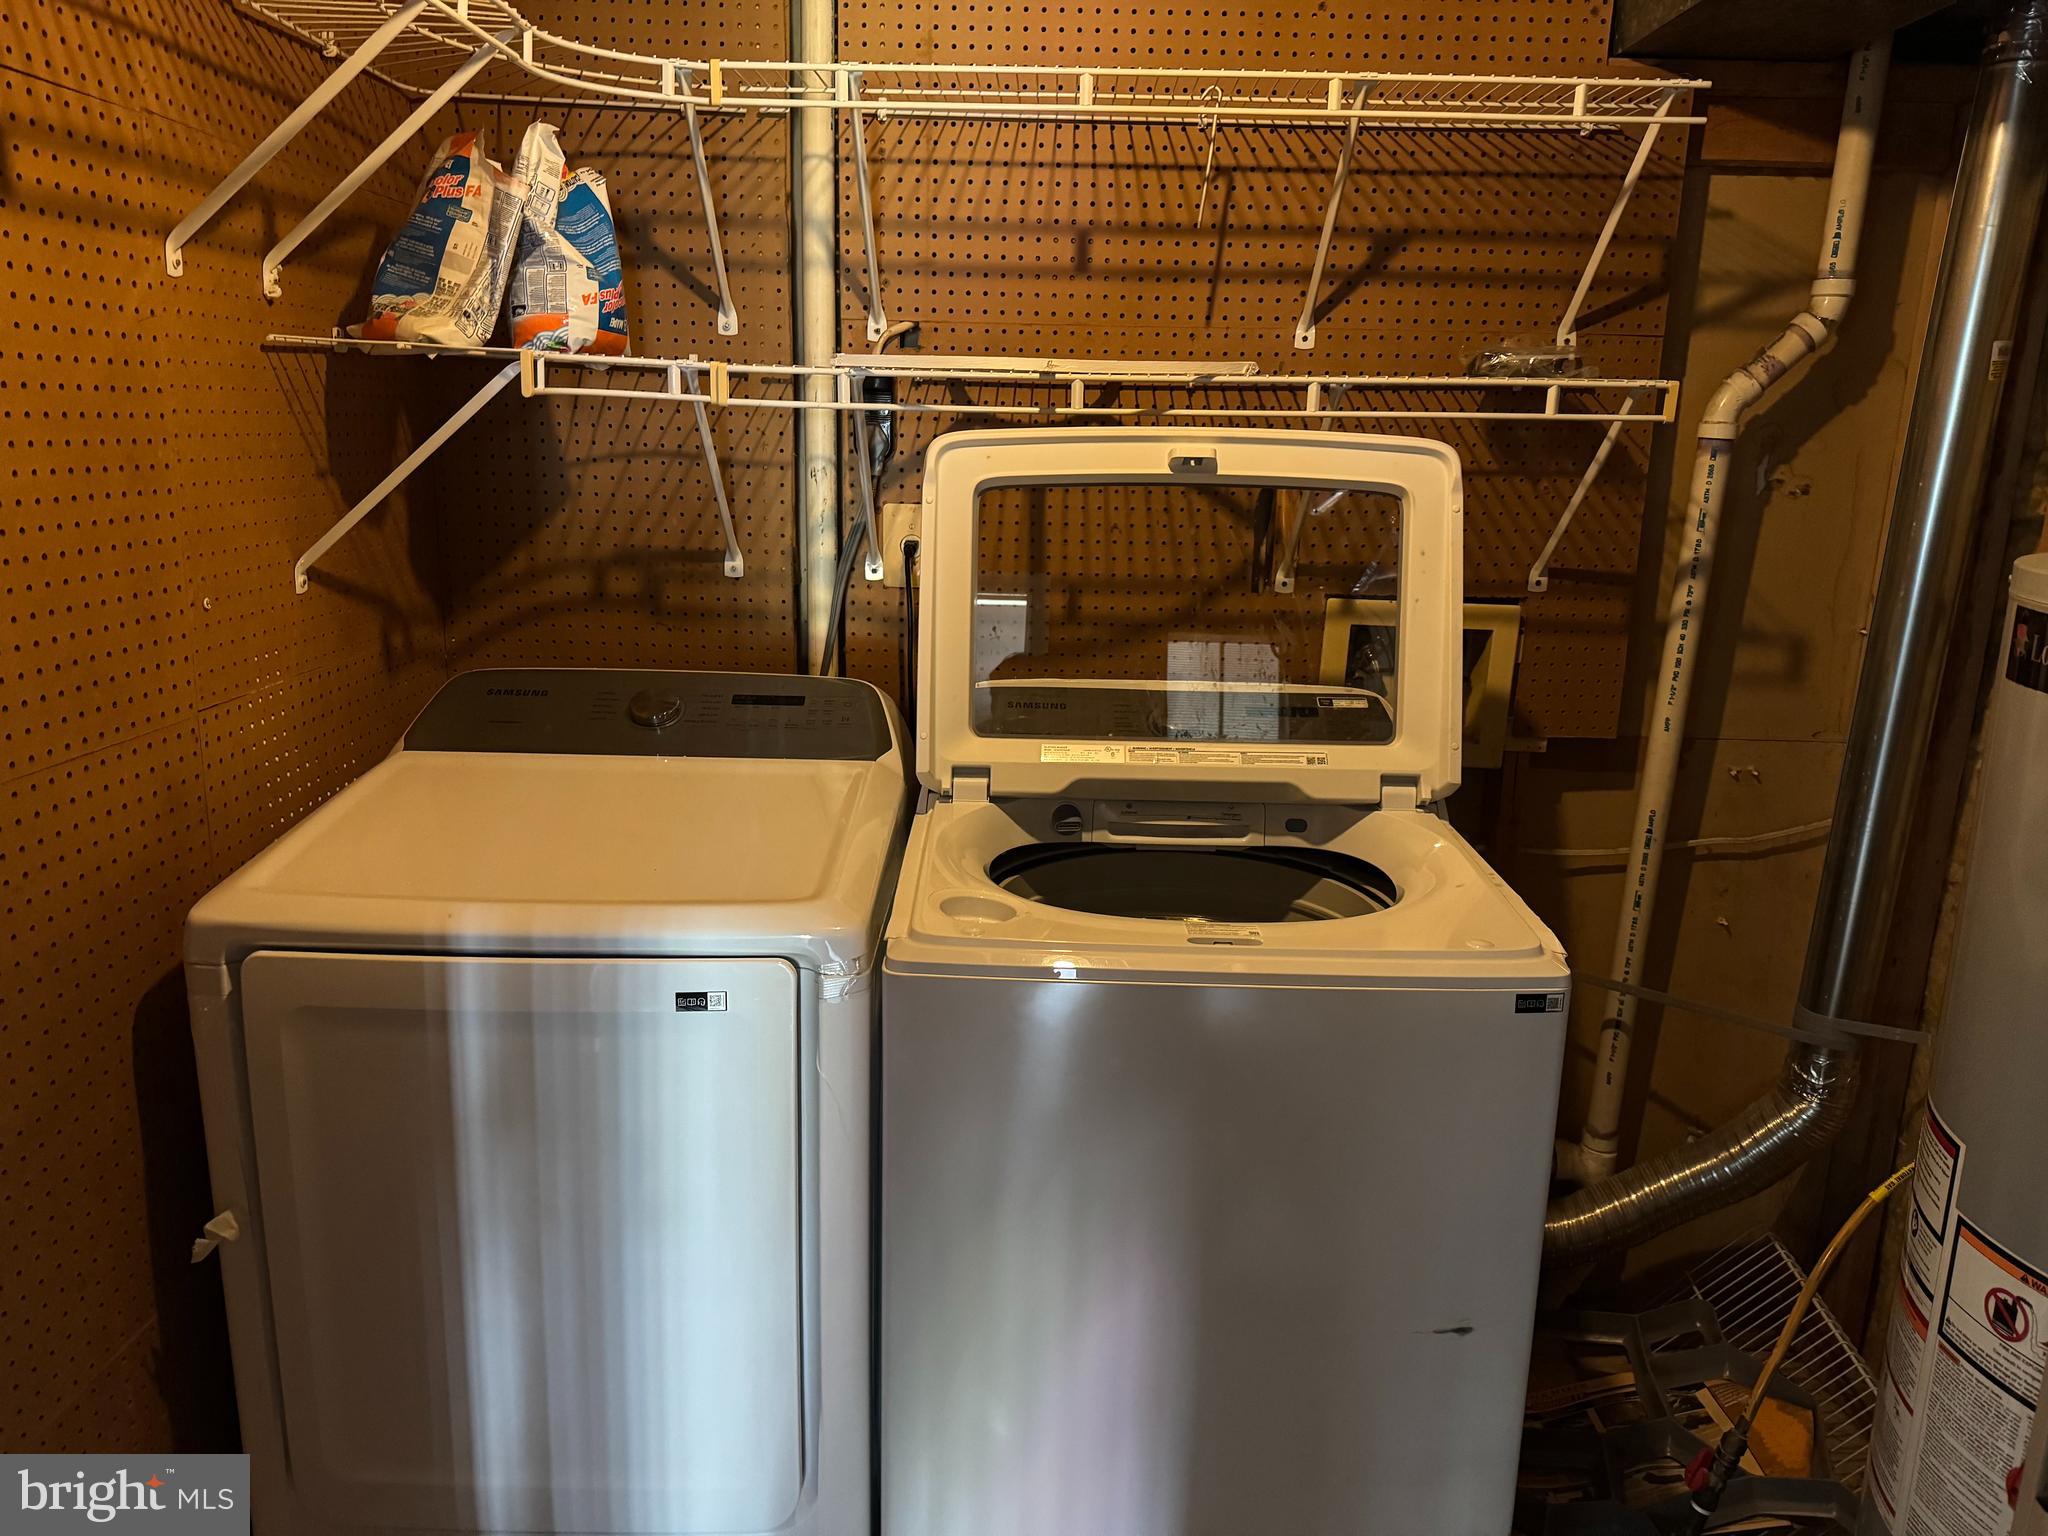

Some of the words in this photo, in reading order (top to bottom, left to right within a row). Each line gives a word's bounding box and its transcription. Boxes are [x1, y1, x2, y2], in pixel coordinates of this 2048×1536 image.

[432, 185, 464, 198] Plus
[465, 184, 482, 197] FA
[582, 292, 597, 305] FA
[599, 286, 621, 302] Plus
[1703, 487, 1711, 504] ASTM
[486, 687, 550, 698] SAMSUNG
[1007, 700, 1067, 710] SAMSUNG
